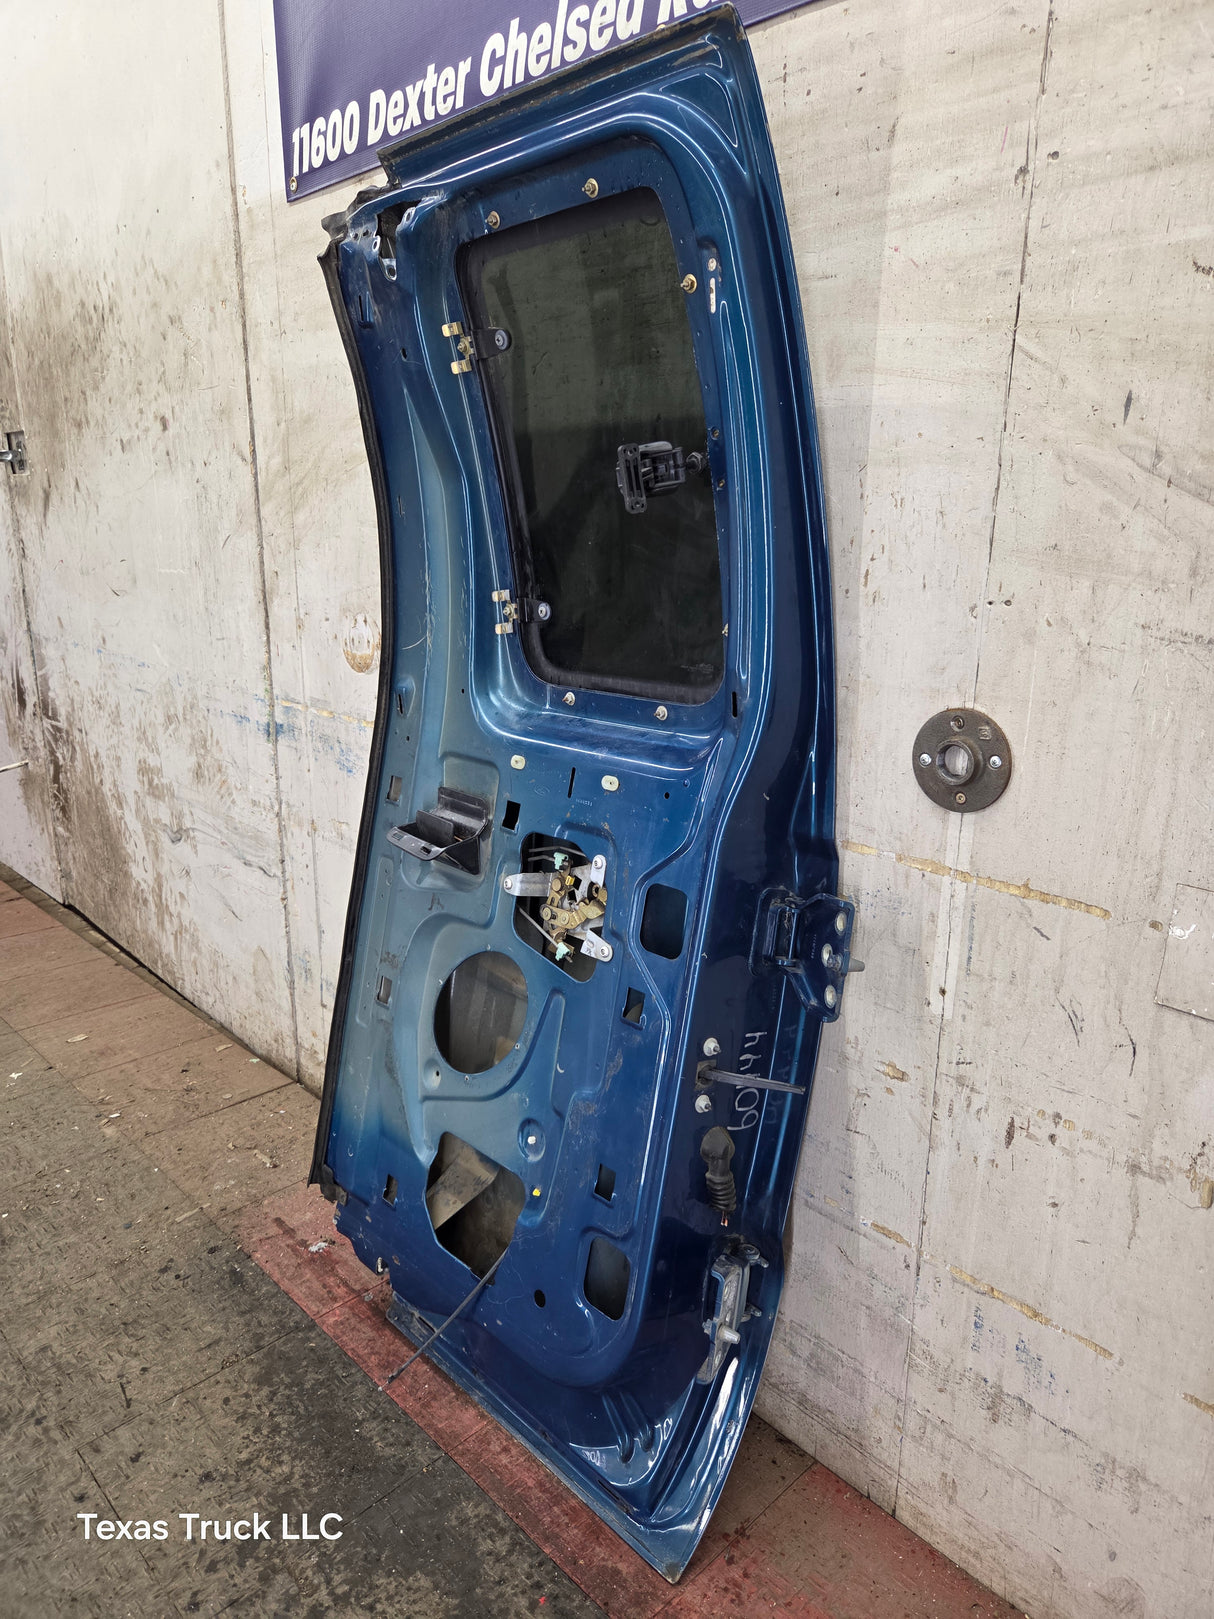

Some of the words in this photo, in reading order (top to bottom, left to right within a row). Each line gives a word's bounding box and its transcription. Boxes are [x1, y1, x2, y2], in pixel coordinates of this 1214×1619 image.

[292, 100, 361, 178] 11600
[367, 56, 472, 147] Dexter
[480, 0, 645, 97] Chelsea
